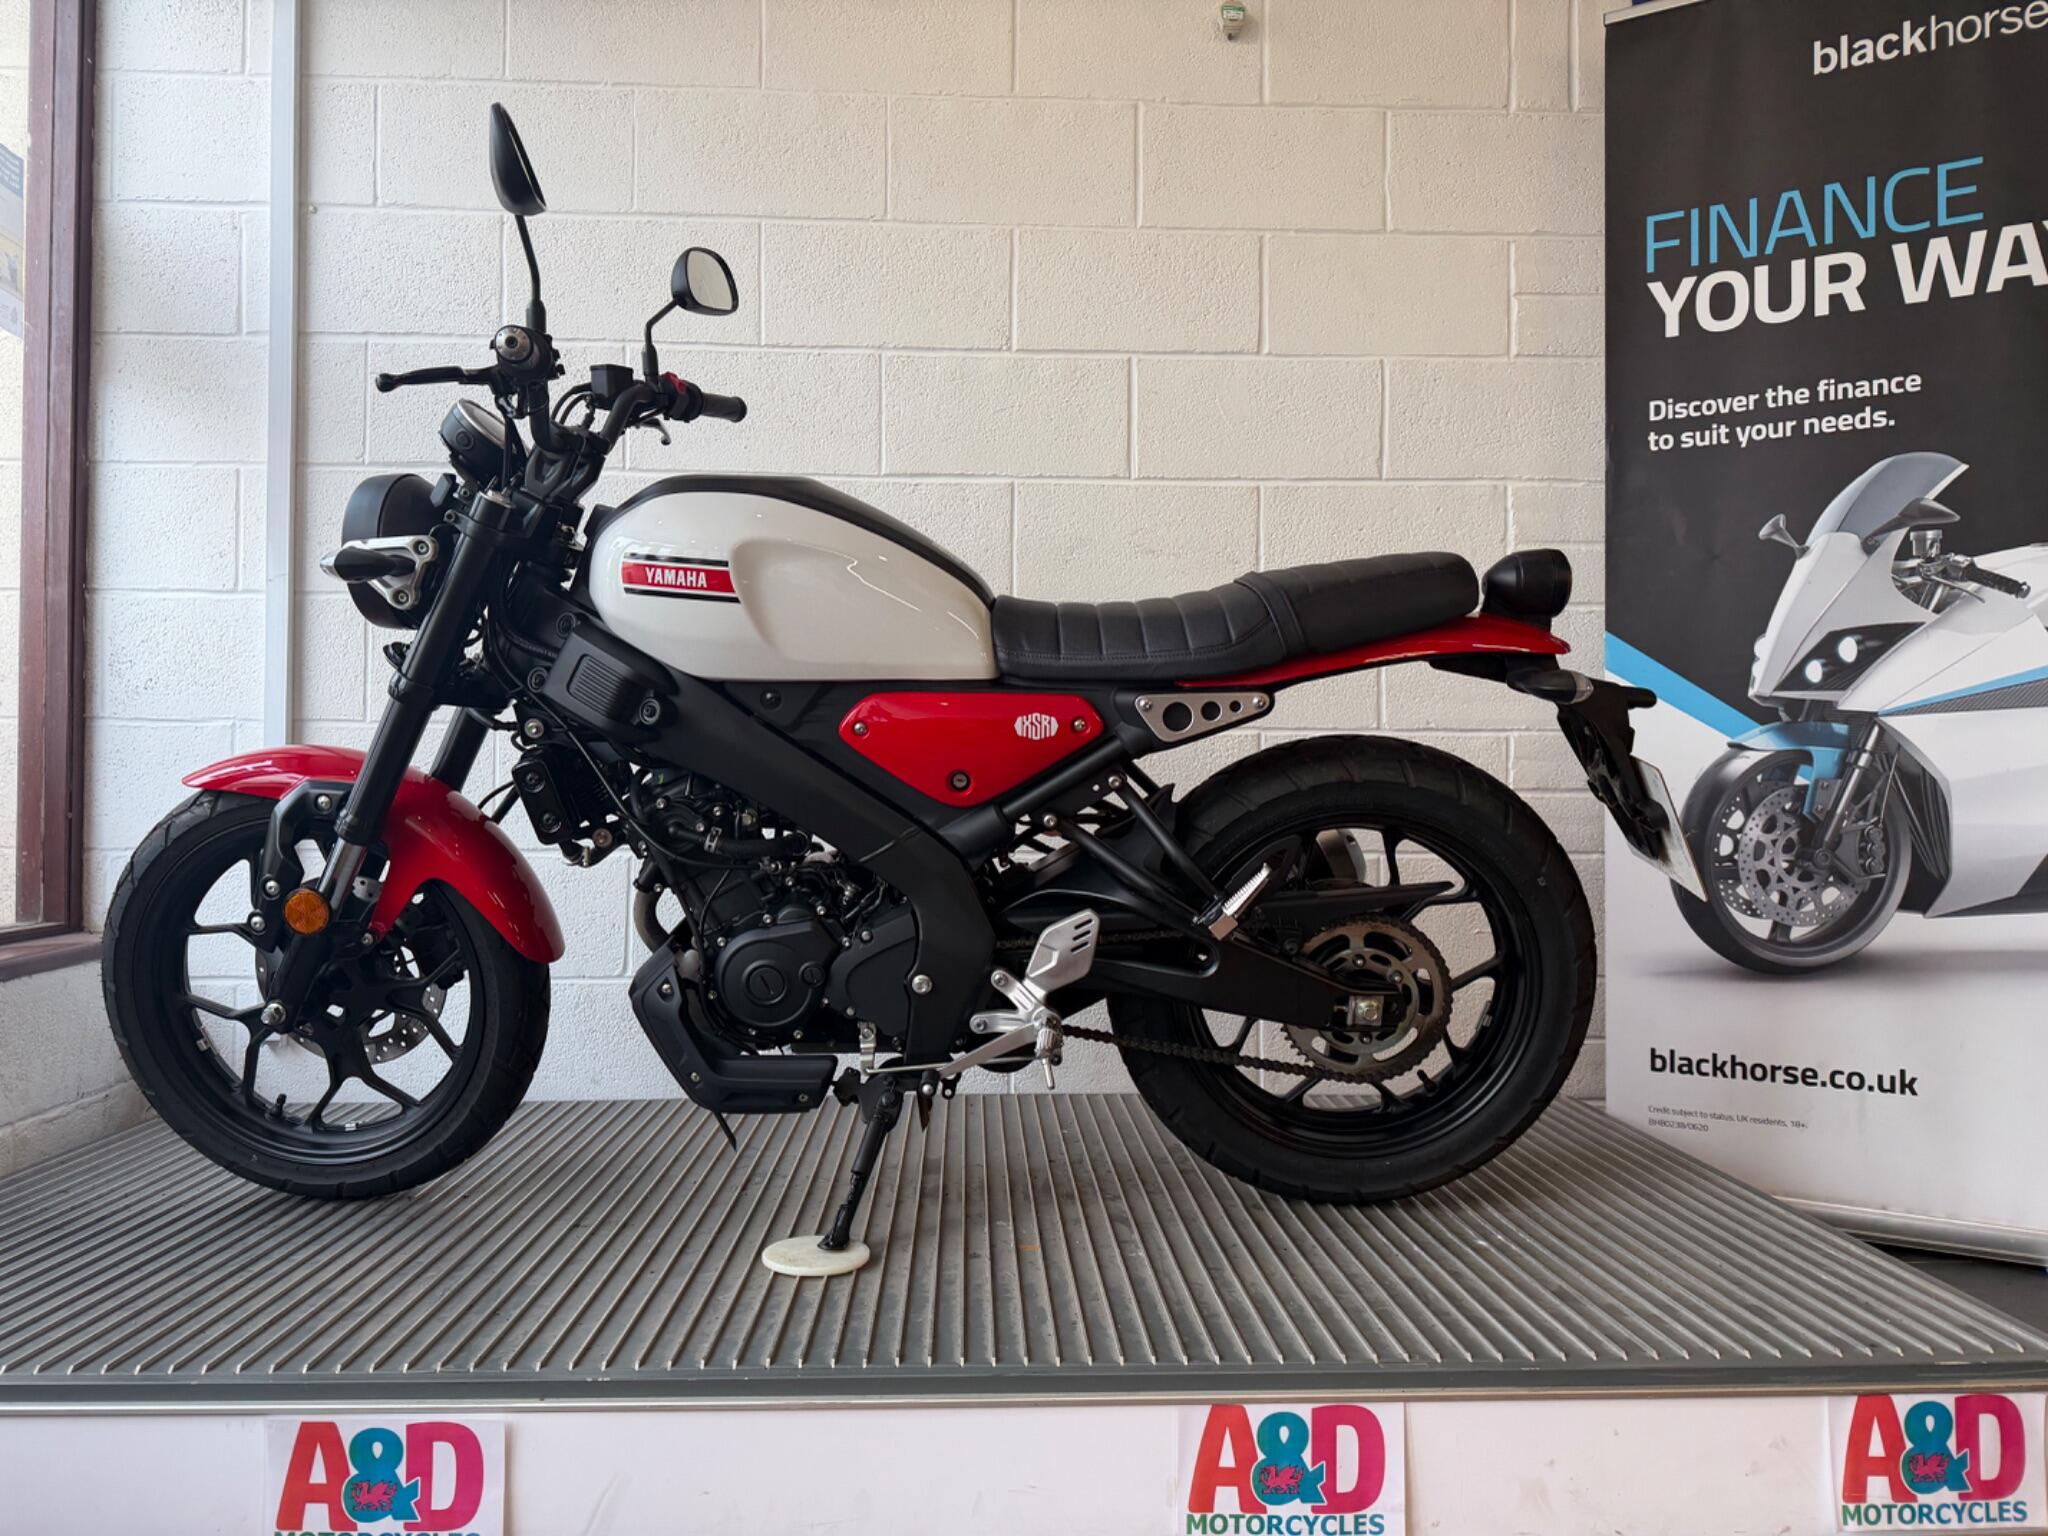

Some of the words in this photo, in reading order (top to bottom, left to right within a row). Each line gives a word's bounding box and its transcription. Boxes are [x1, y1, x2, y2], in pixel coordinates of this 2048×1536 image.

[1813, 0, 2048, 75] blackhorse
[1646, 156, 1984, 273] FINANCE
[1646, 251, 1867, 338] YOUR
[1891, 219, 2048, 305] WA
[1649, 393, 1760, 421] Discover
[1765, 385, 1810, 408] the
[1817, 374, 1922, 402] finance
[1648, 431, 1674, 451] to
[1680, 424, 1730, 448] suit
[1736, 419, 1797, 448] your
[1803, 406, 1895, 435] needs.
[645, 567, 707, 588] YAMAHA
[1021, 712, 1052, 740] XSR
[1649, 1047, 1919, 1096] blackhorse.co.uk
[1648, 1105, 1670, 1116] Credit
[1672, 1107, 1698, 1119] subject
[1700, 1110, 1708, 1119] to
[1736, 1114, 1749, 1123] UK
[1188, 1403, 1386, 1514] A&D
[1842, 1393, 2026, 1503] A&D
[275, 1421, 484, 1531] A&D
[1186, 1513, 1385, 1536] MOTORCYCLES
[1842, 1501, 2028, 1526] MOTORCYCLES
